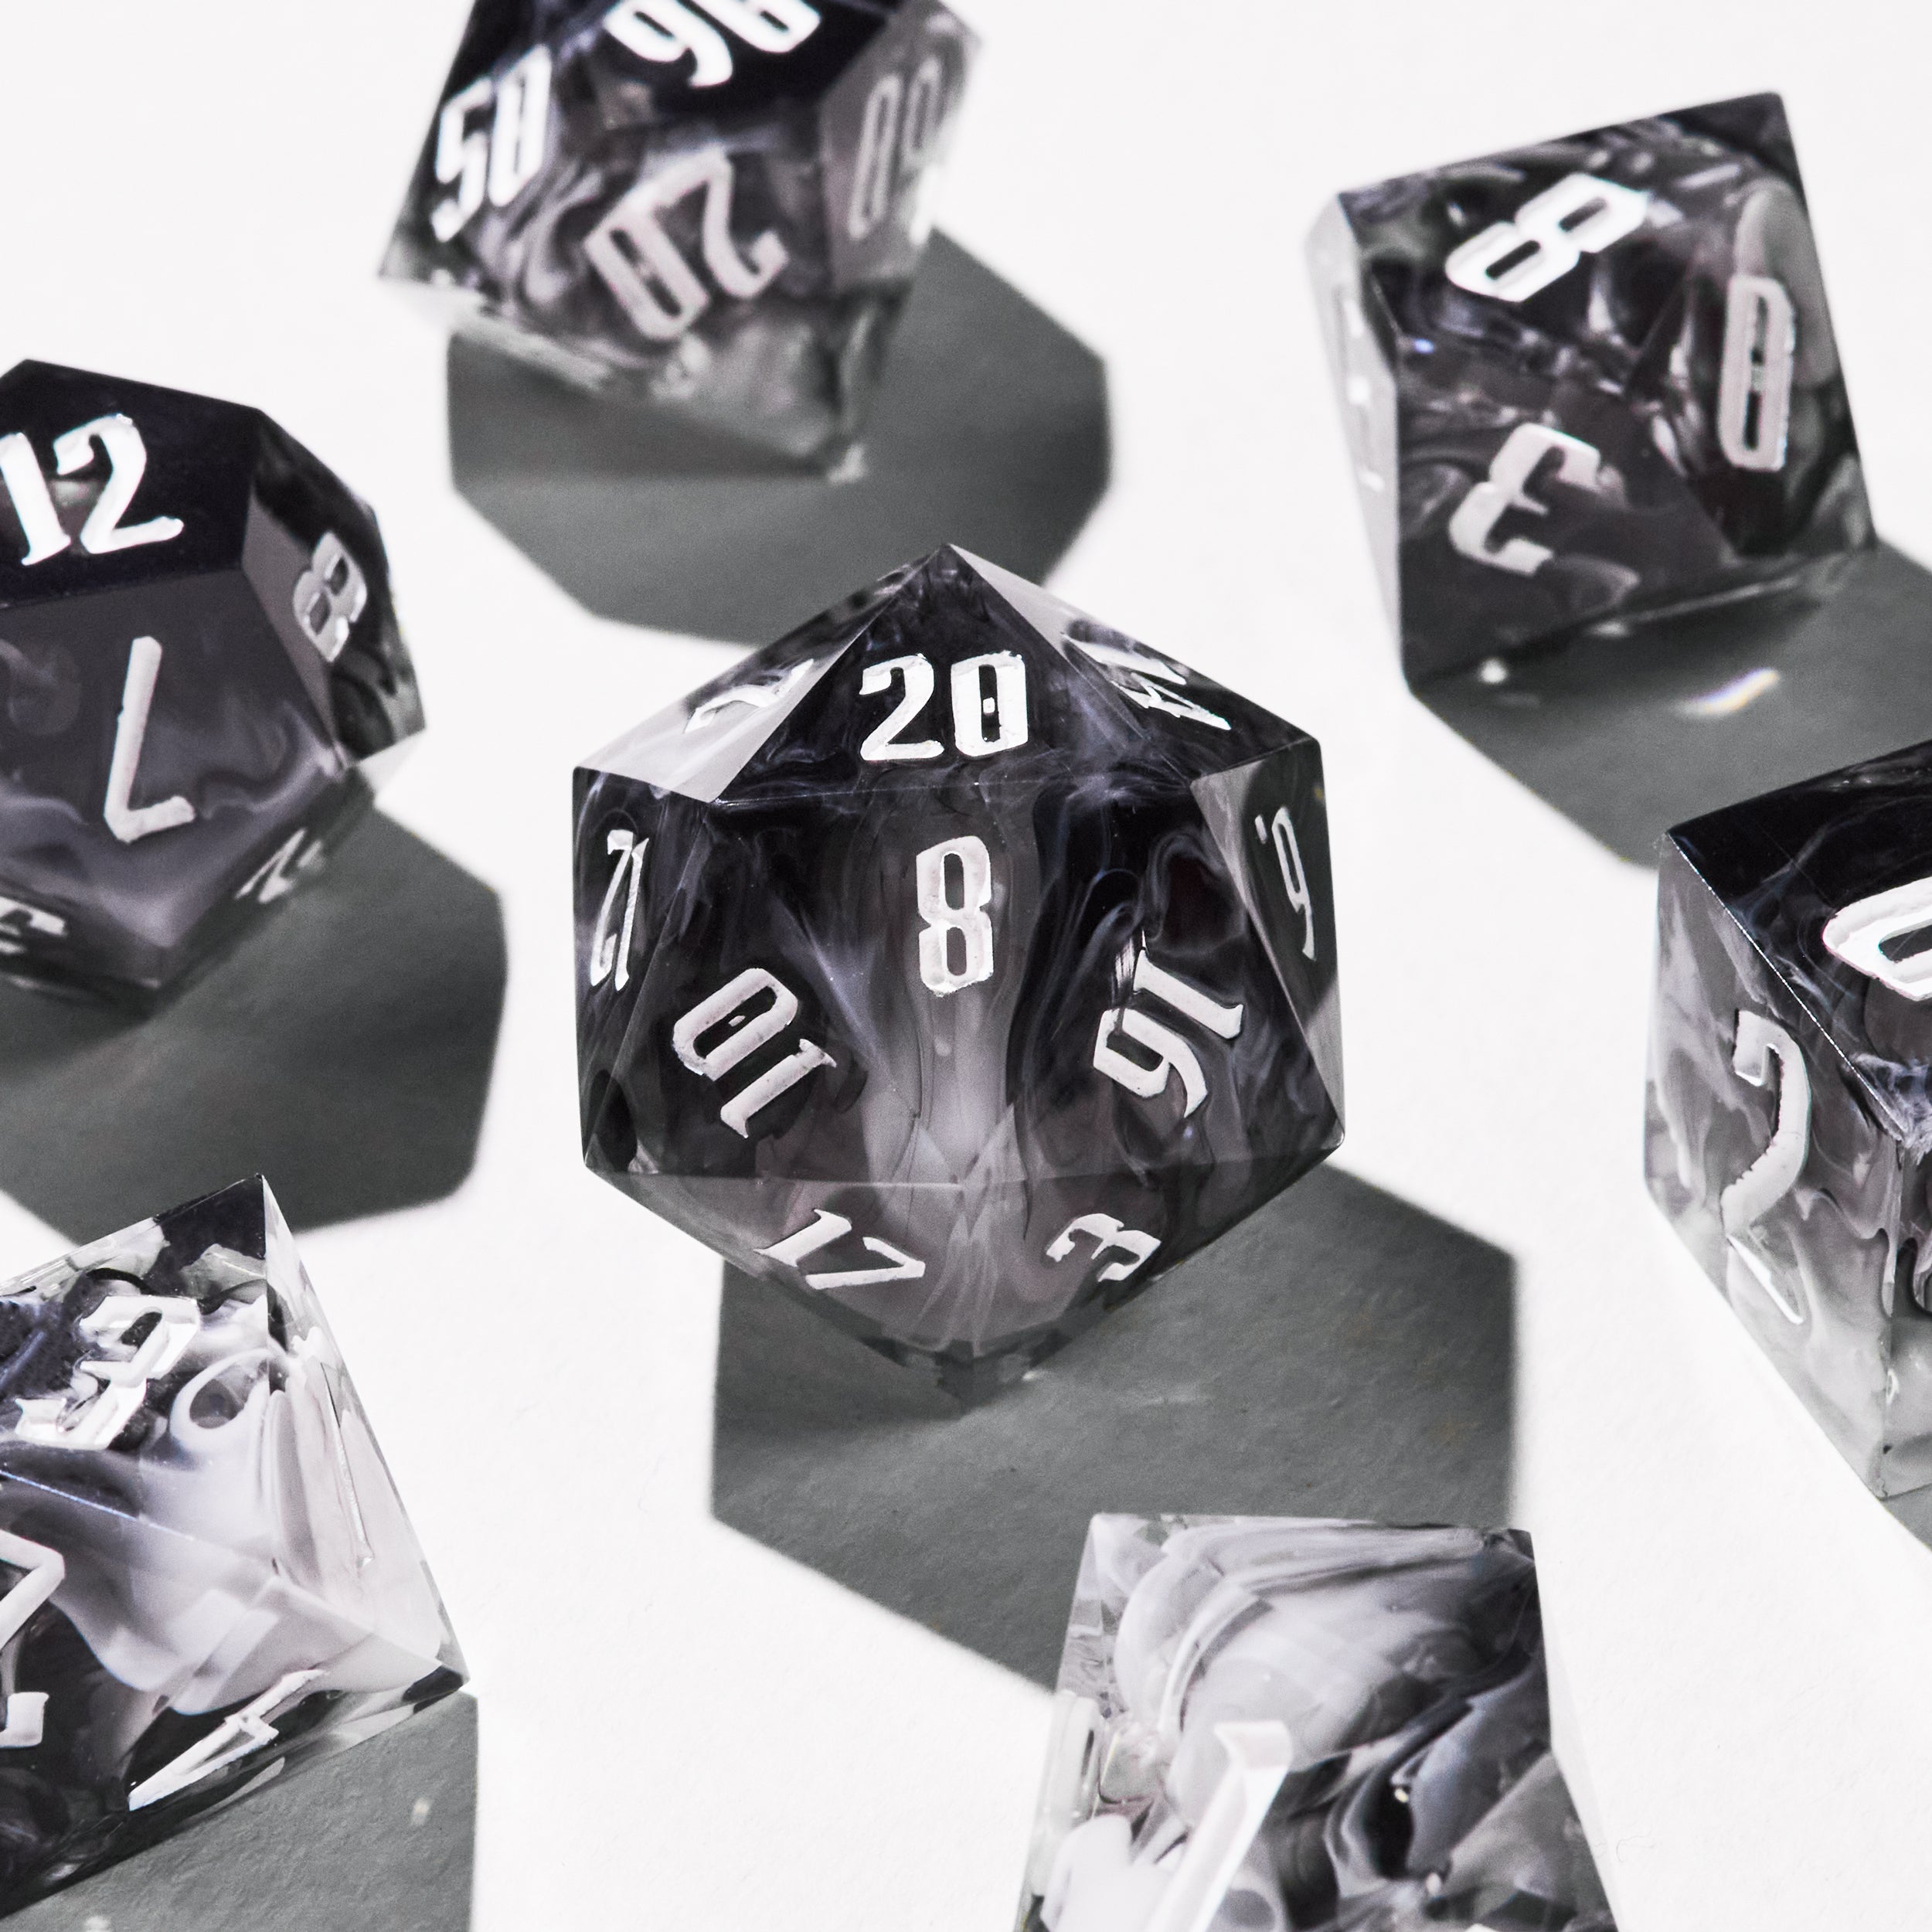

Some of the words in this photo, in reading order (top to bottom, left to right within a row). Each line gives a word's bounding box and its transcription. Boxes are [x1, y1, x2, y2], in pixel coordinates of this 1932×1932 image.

[431, 43, 552, 242] 50
[583, 145, 788, 342] 20
[1444, 172, 1651, 304] 8
[1717, 273, 1795, 472] 0
[0, 413, 185, 566] 12
[1448, 422, 1600, 577] 3
[292, 529, 368, 664] 8
[103, 635, 196, 844] 7
[858, 651, 1029, 762] 20
[590, 828, 650, 992] 12
[915, 835, 995, 998] 8
[672, 967, 837, 1139] 10
[753, 1208, 927, 1291] 17
[1046, 1212, 1162, 1284] 3
[13, 1294, 201, 1451] 3
[127, 1667, 331, 1811] 4
